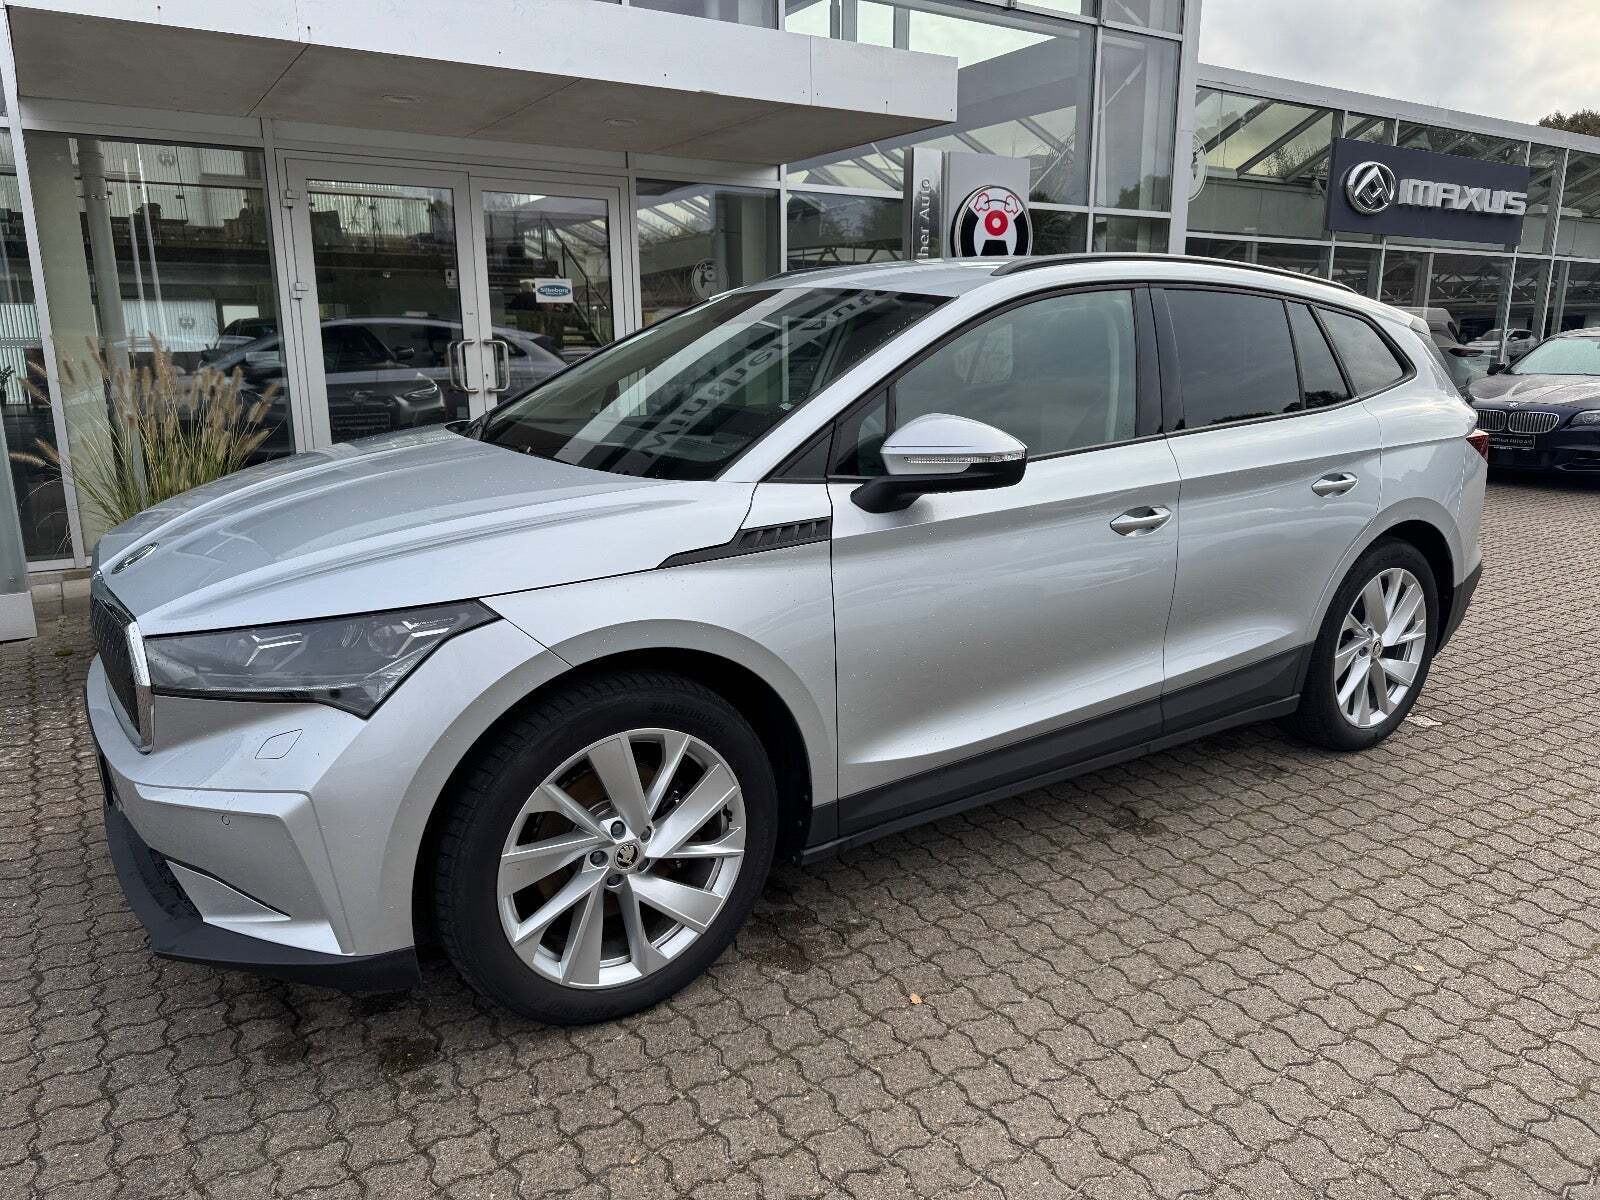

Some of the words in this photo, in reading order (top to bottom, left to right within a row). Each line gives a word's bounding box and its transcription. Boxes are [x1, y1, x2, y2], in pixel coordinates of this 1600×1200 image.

[919, 178, 931, 220] Auto
[1398, 179, 1528, 215] MAXUS
[917, 226, 930, 257] her
